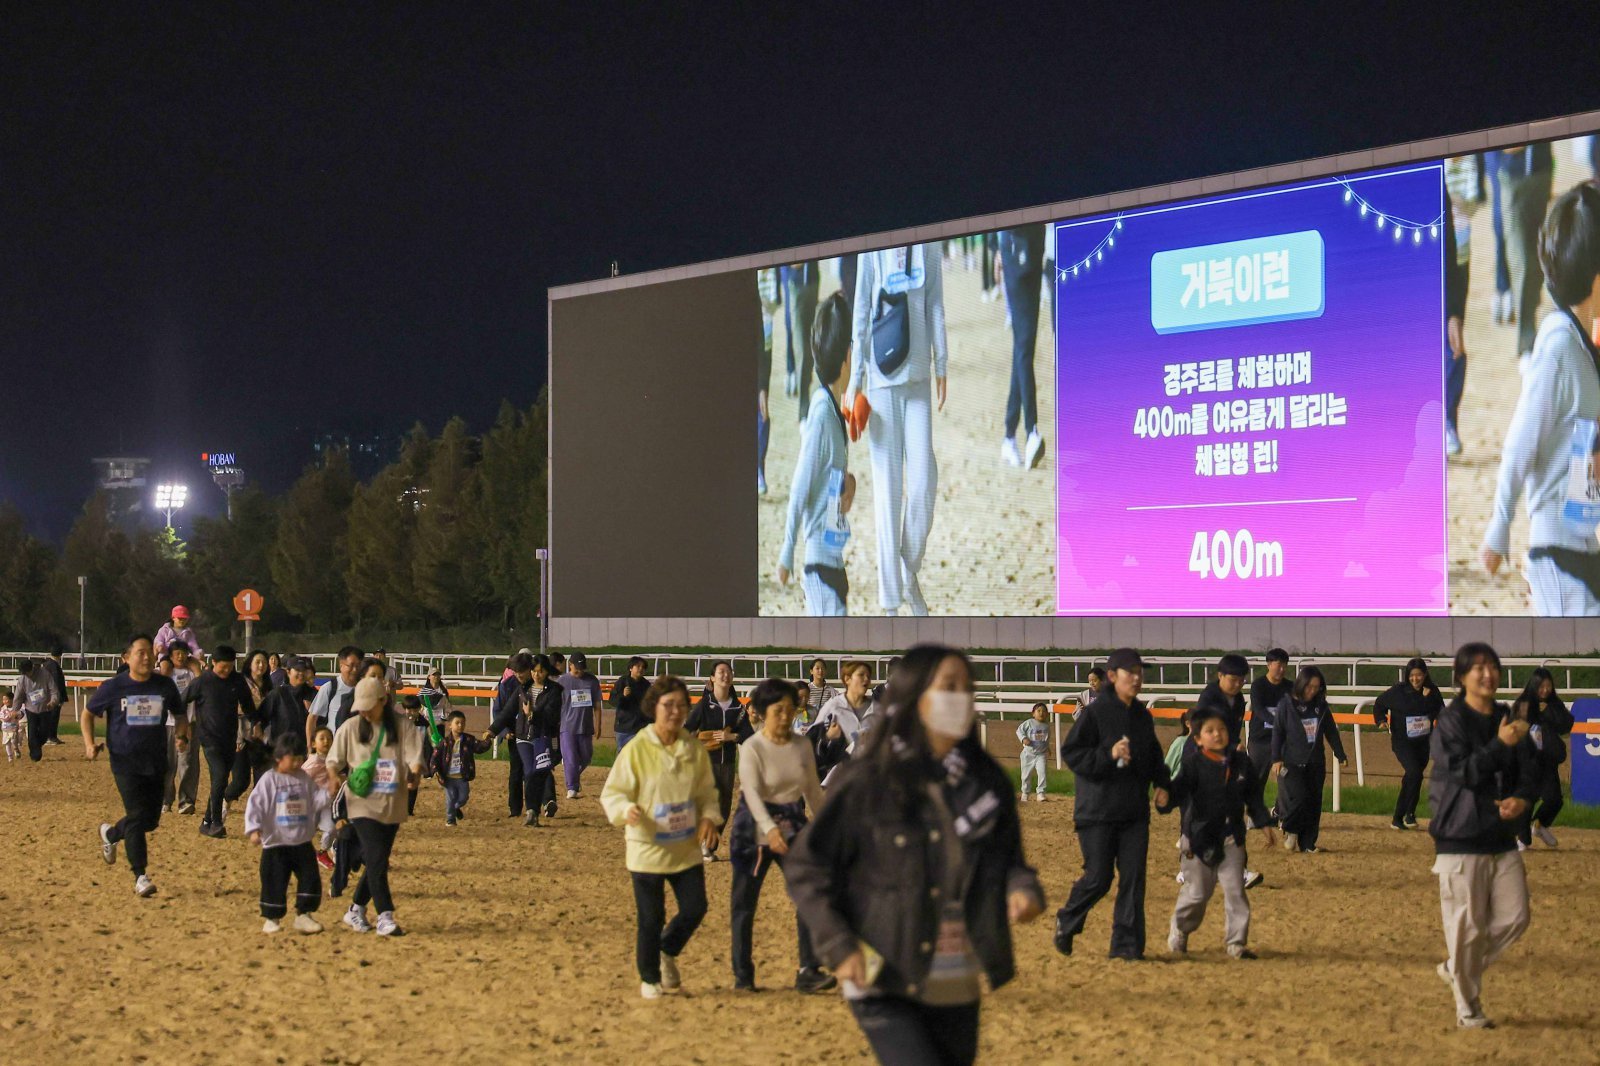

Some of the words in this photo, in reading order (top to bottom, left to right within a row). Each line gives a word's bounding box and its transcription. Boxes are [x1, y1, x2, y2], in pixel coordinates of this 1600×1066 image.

[1180, 249, 1290, 309] 거북이런
[1163, 358, 1234, 397] 경주로를
[1237, 350, 1312, 389] 체험하며
[1133, 402, 1209, 439] 400m를
[1212, 396, 1286, 434] 여유롭게
[1289, 392, 1348, 429] 달리는
[209, 452, 235, 466] HOBAN
[1195, 442, 1249, 477] 체험형
[1253, 439, 1279, 474] 런!
[1188, 528, 1284, 580] 400m
[242, 592, 251, 611] 1
